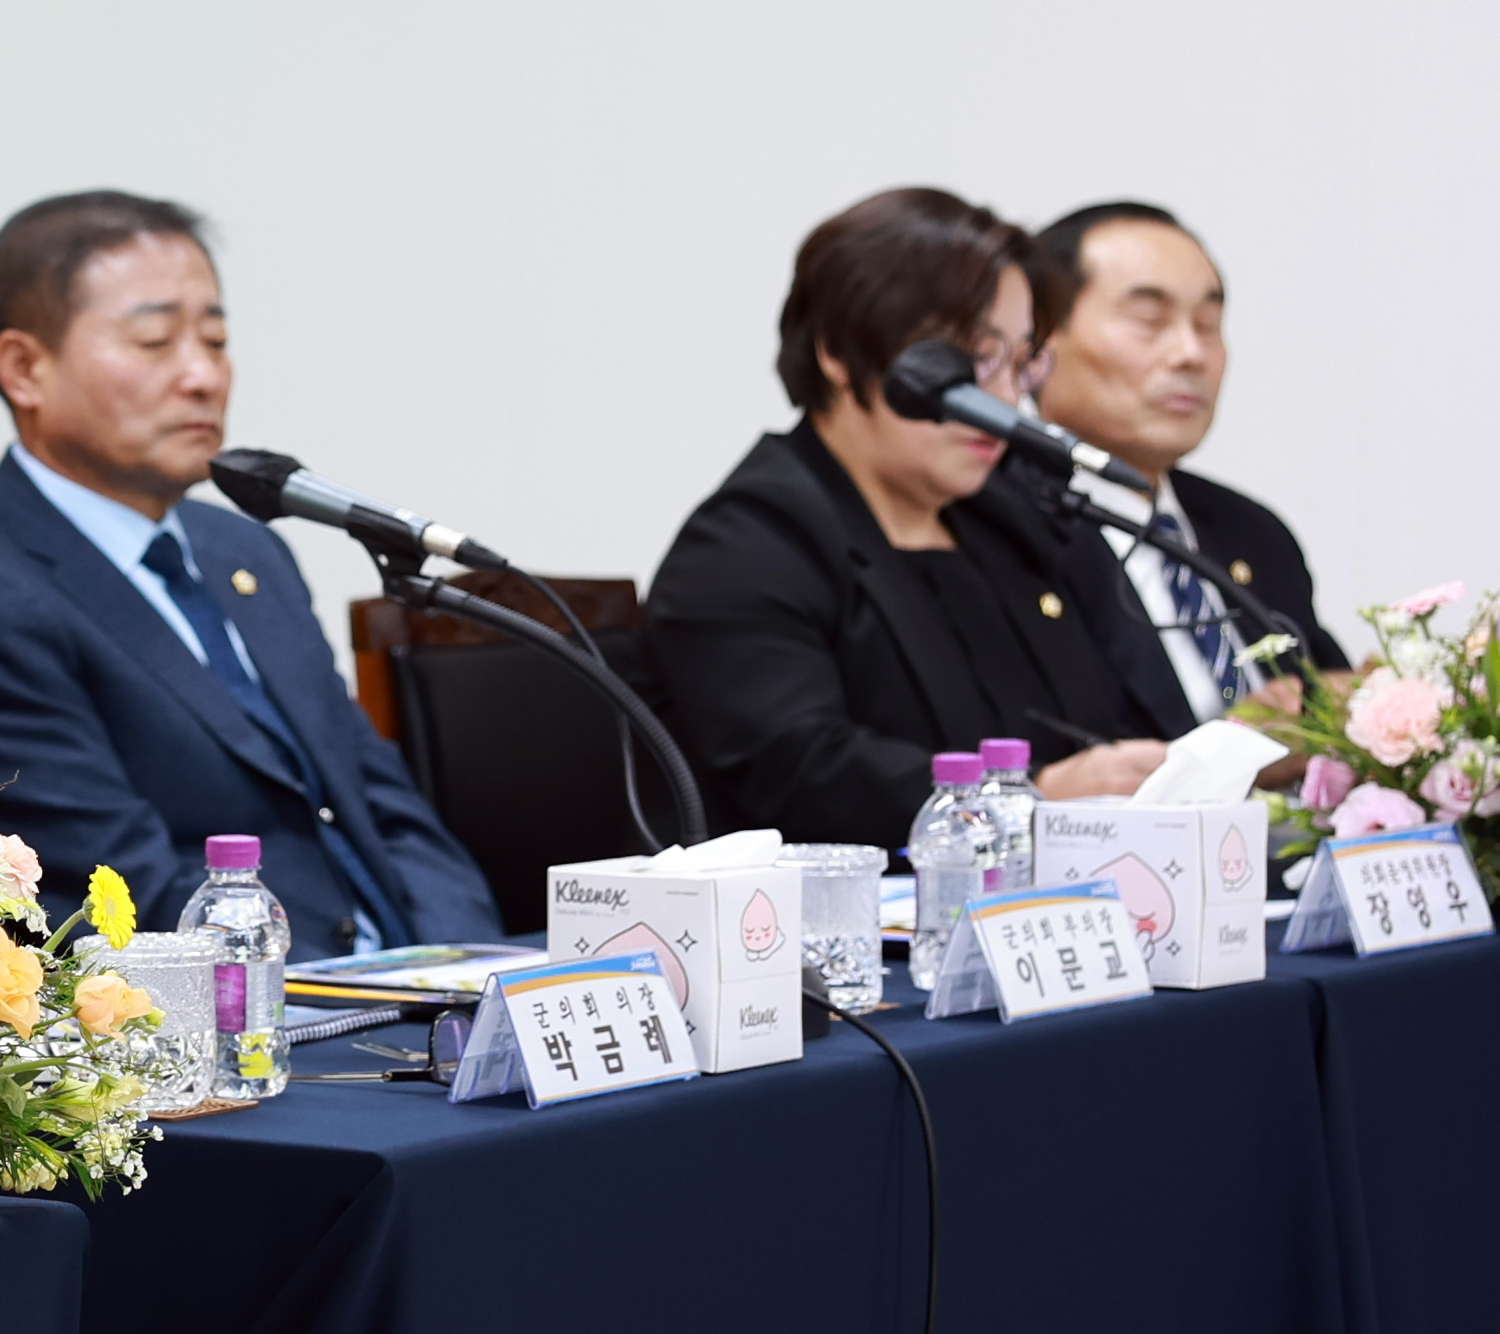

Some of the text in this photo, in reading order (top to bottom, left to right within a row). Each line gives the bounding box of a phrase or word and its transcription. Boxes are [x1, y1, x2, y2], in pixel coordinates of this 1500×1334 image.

[555, 878, 630, 910] Kleenex
[532, 982, 656, 1030] 군의회 의장
[739, 1004, 779, 1030] Kleenex
[541, 1014, 673, 1082] 박금례
